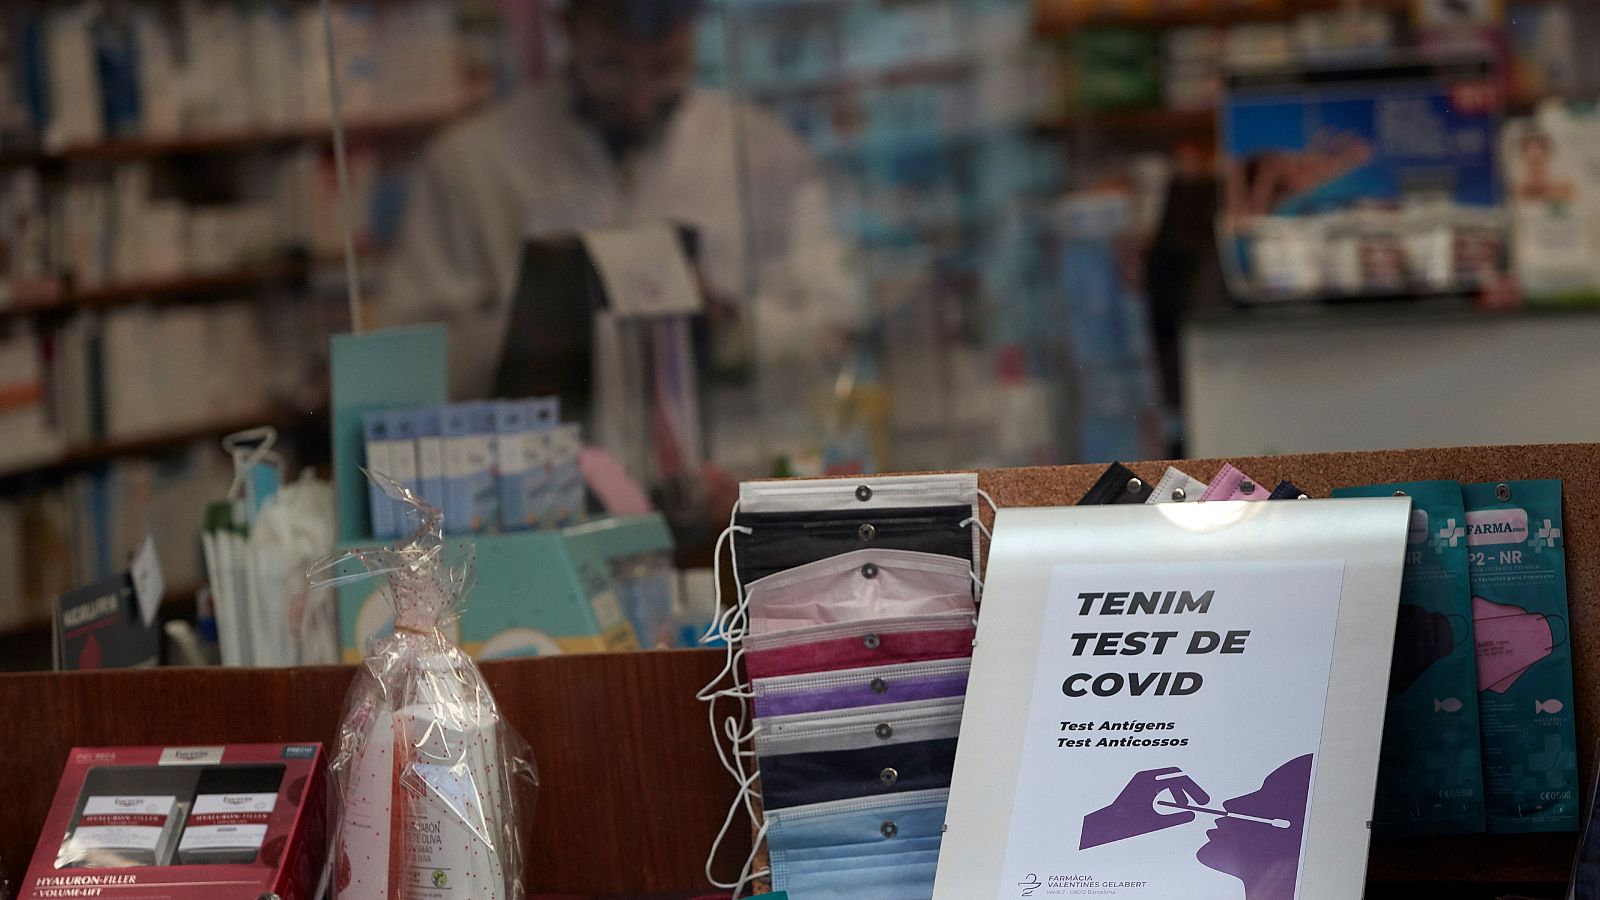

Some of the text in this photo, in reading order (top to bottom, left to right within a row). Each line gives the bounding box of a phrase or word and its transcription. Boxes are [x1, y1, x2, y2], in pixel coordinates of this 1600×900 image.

[1500, 550, 1522, 564] NR
[1077, 590, 1215, 616] TENIM
[1070, 630, 1251, 657] TEST DE
[1061, 672, 1204, 698] COVID
[1060, 720, 1176, 733] Test Antígens
[1057, 736, 1189, 748] Test Anticossos
